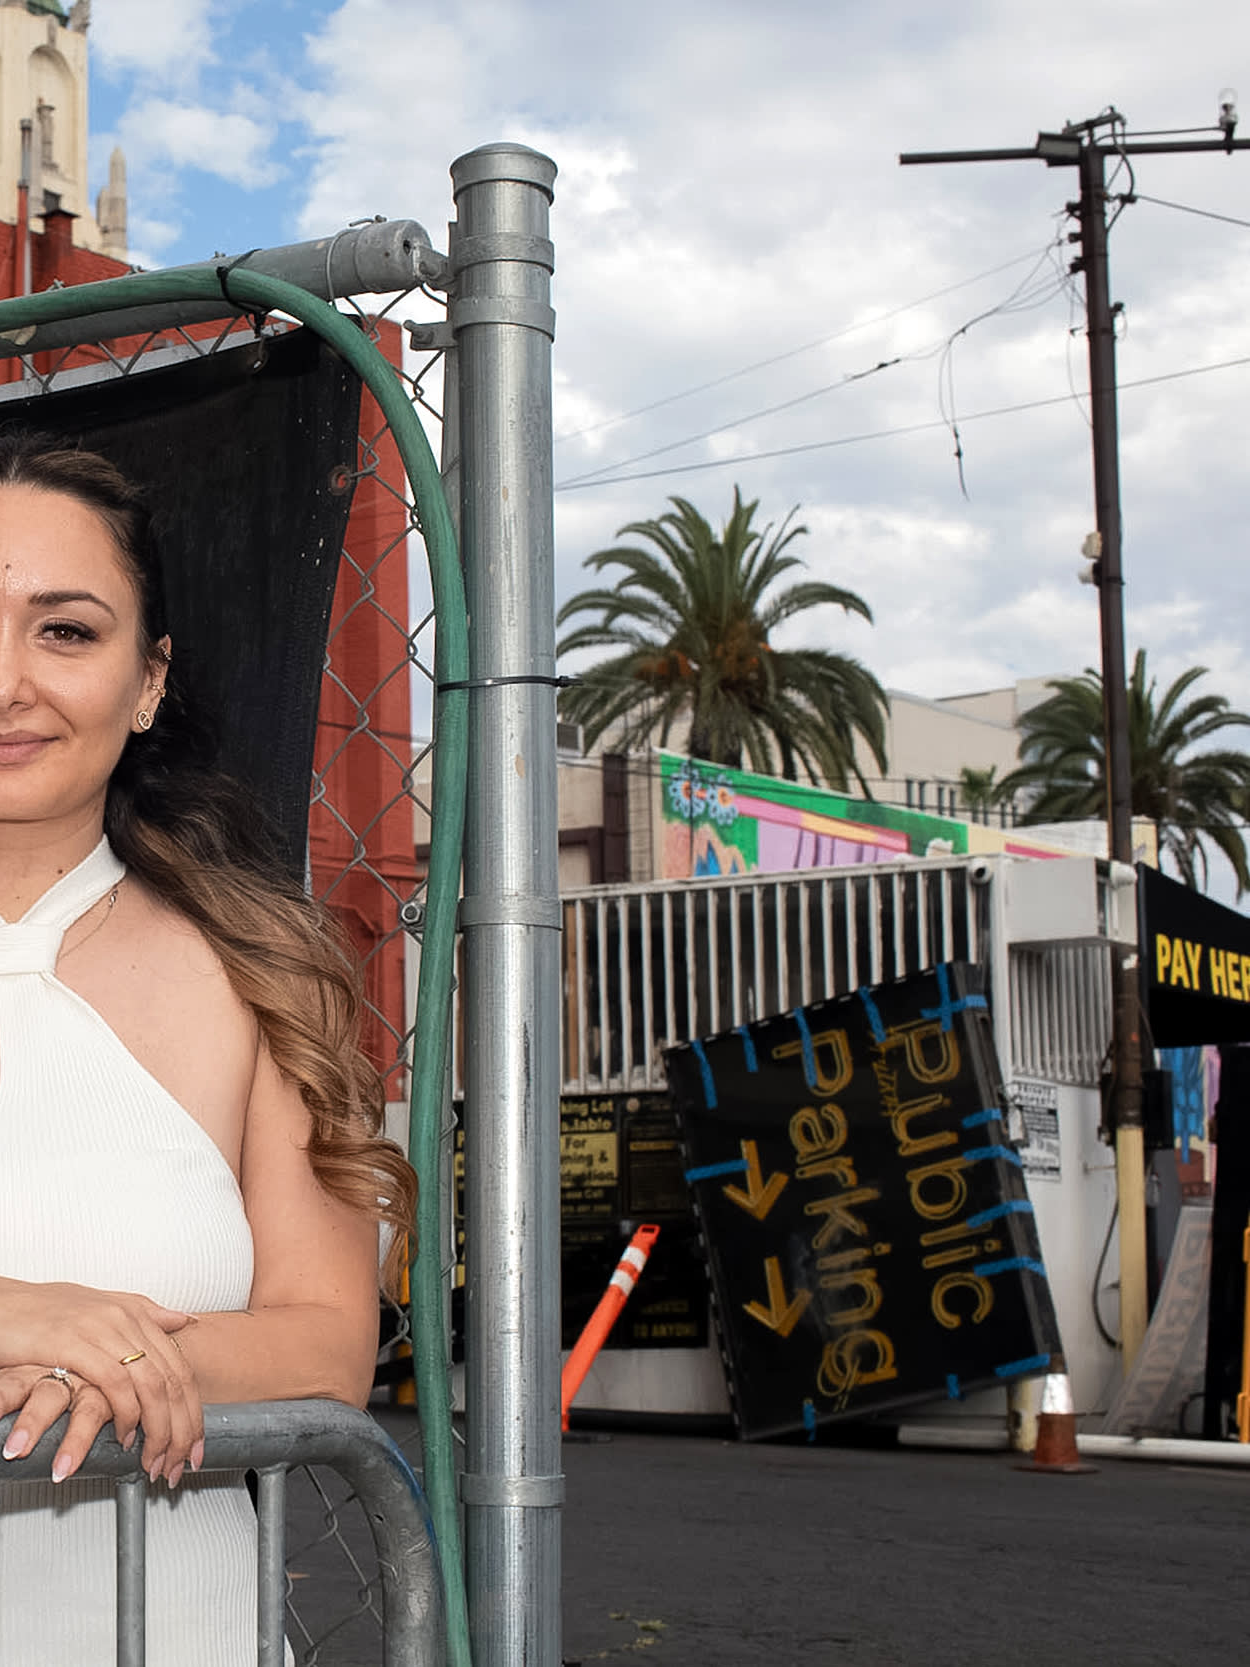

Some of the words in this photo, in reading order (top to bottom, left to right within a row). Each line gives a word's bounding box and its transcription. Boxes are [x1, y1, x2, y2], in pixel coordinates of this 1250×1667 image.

[1156, 933, 1202, 990] PAY
[772, 1029, 897, 1397] Parking
[875, 1019, 1003, 1329] Public
